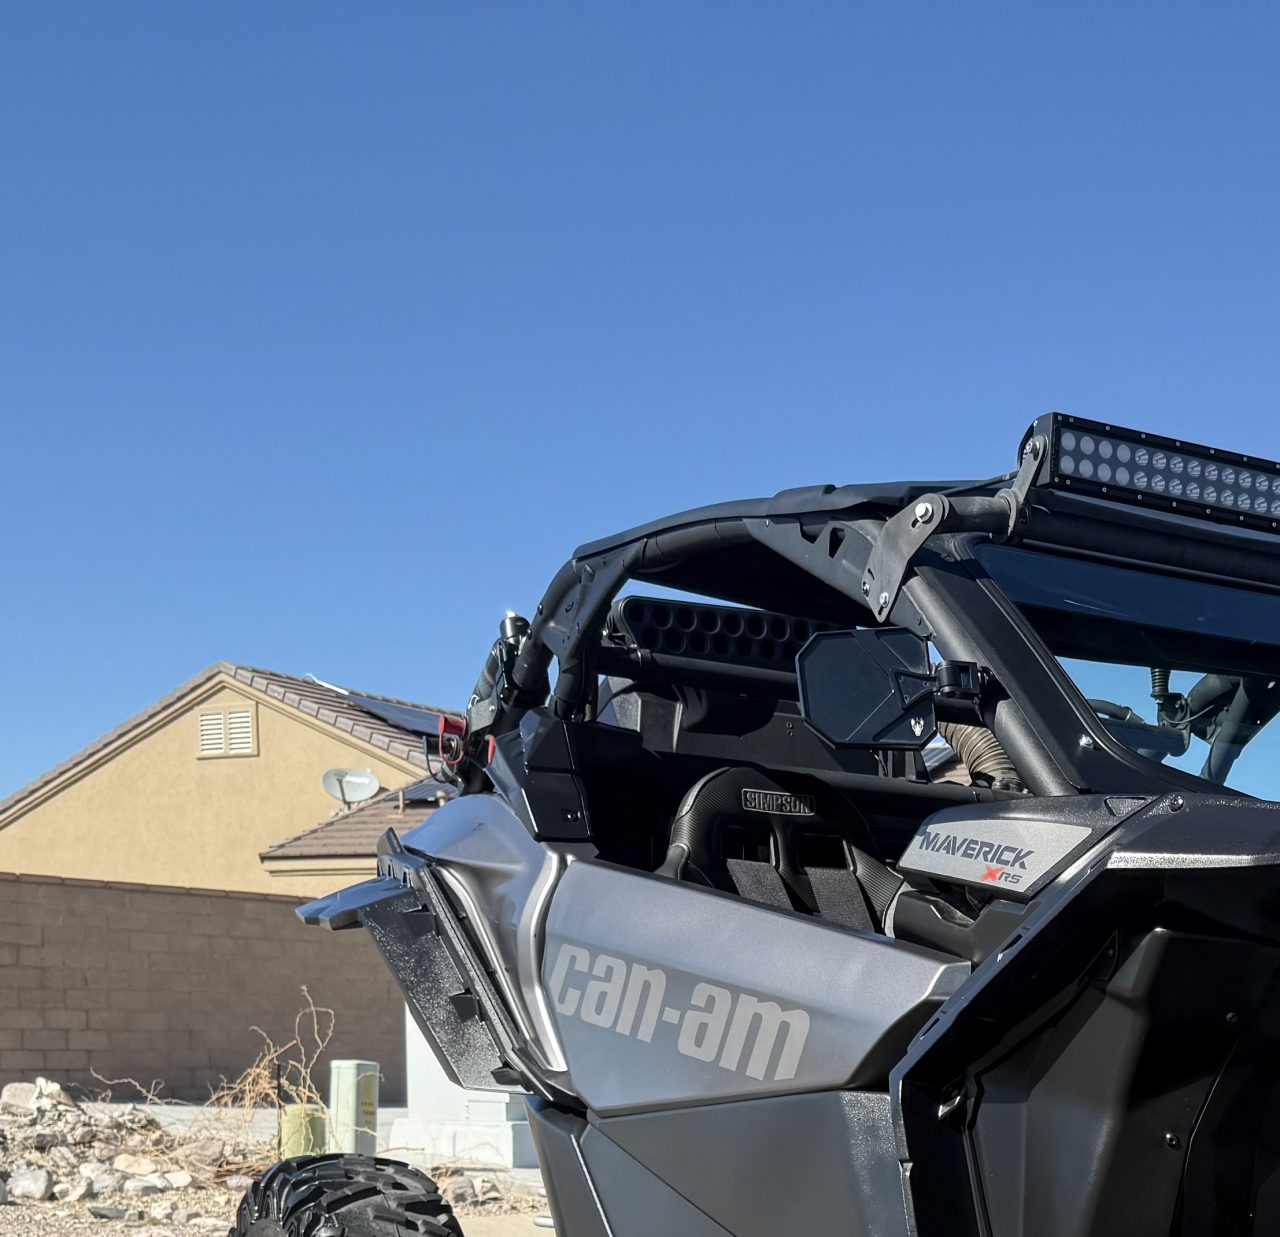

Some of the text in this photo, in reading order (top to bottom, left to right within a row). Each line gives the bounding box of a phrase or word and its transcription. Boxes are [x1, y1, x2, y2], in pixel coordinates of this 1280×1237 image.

[746, 792, 812, 814] SIMPSON
[919, 832, 1035, 870] MAVERICK
[980, 865, 1023, 884] XRS
[549, 943, 811, 1081] can-am
